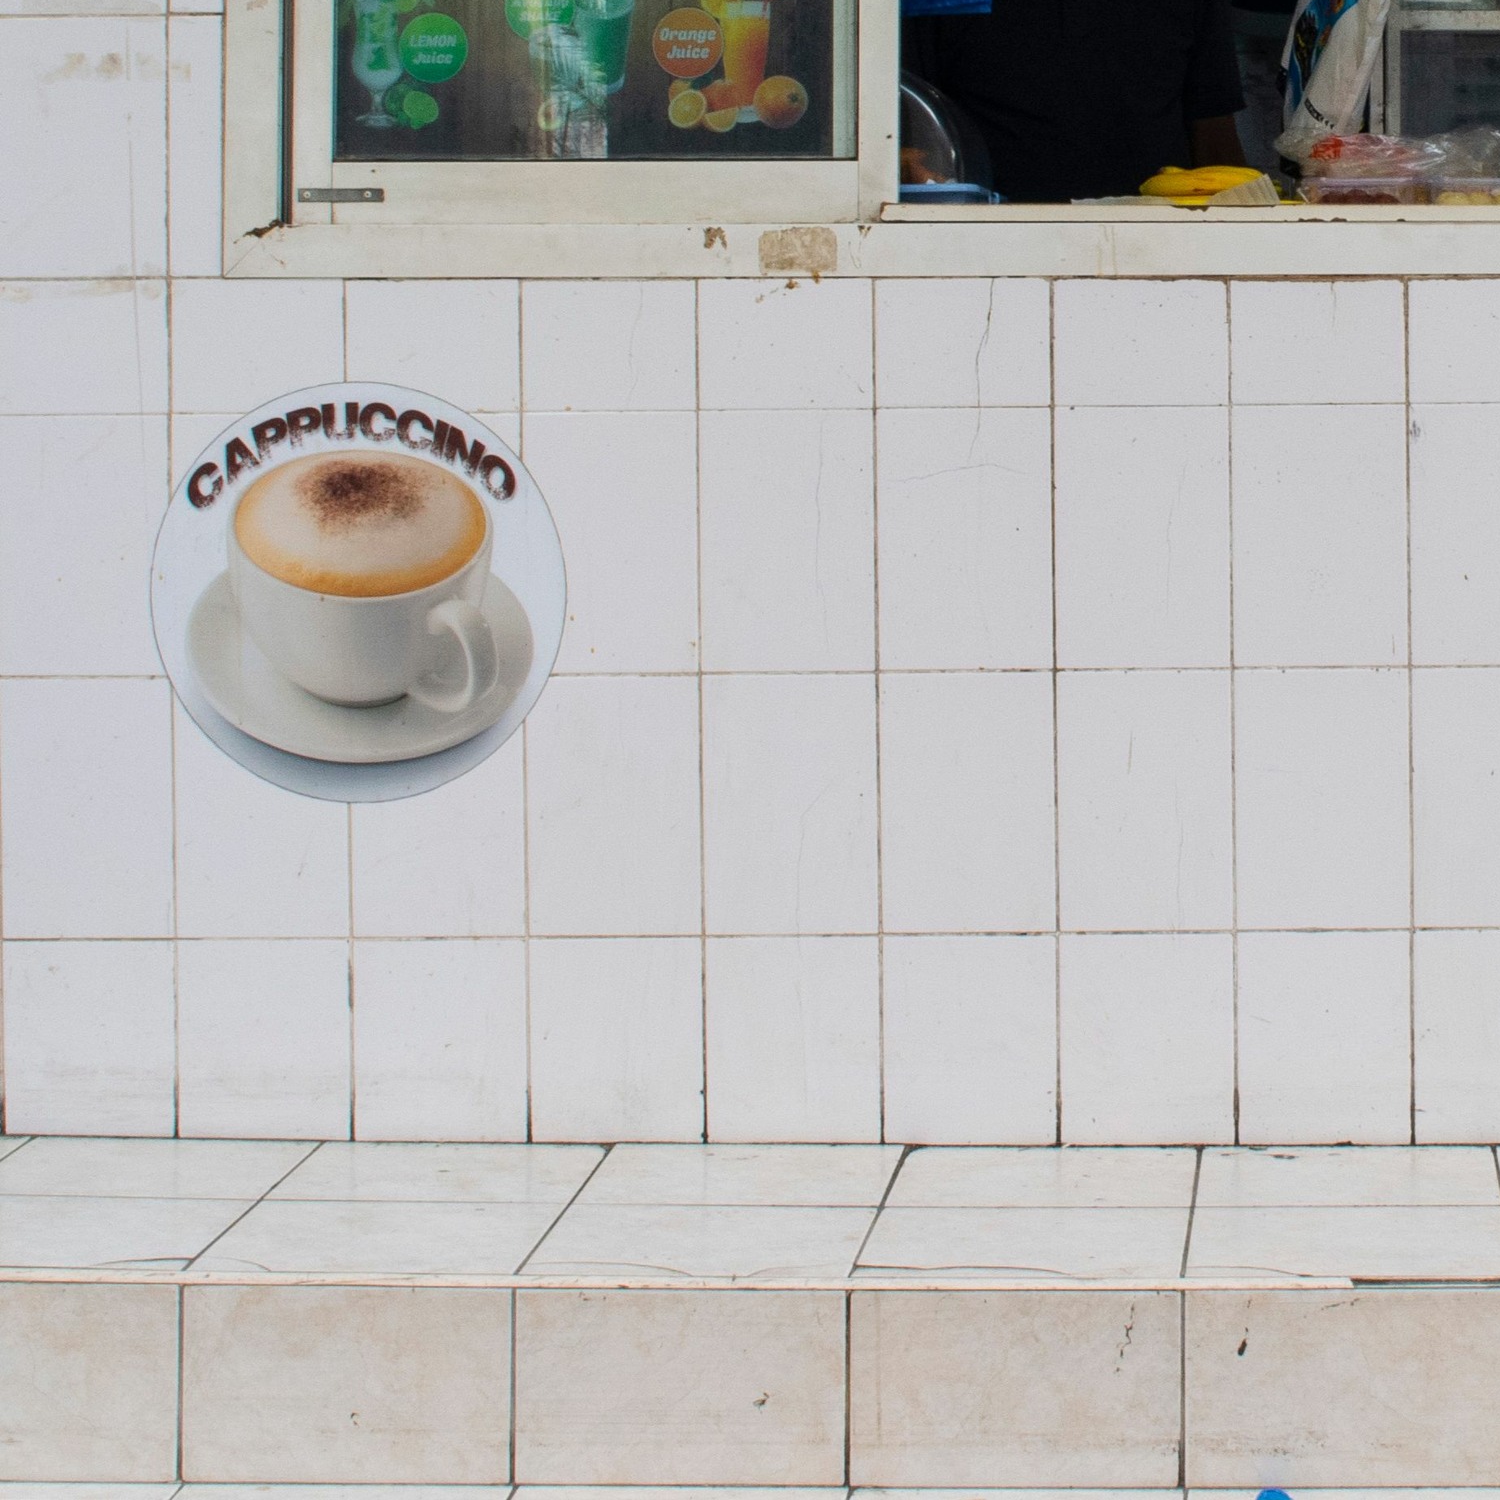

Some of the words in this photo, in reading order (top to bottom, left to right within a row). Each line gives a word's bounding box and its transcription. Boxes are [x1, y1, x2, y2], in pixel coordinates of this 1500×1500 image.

[408, 34, 457, 47] LEMON
[659, 27, 718, 43] Orange
[412, 53, 454, 66] Juice
[666, 45, 711, 60] Juice
[186, 401, 518, 510] CAPPUCCINO
